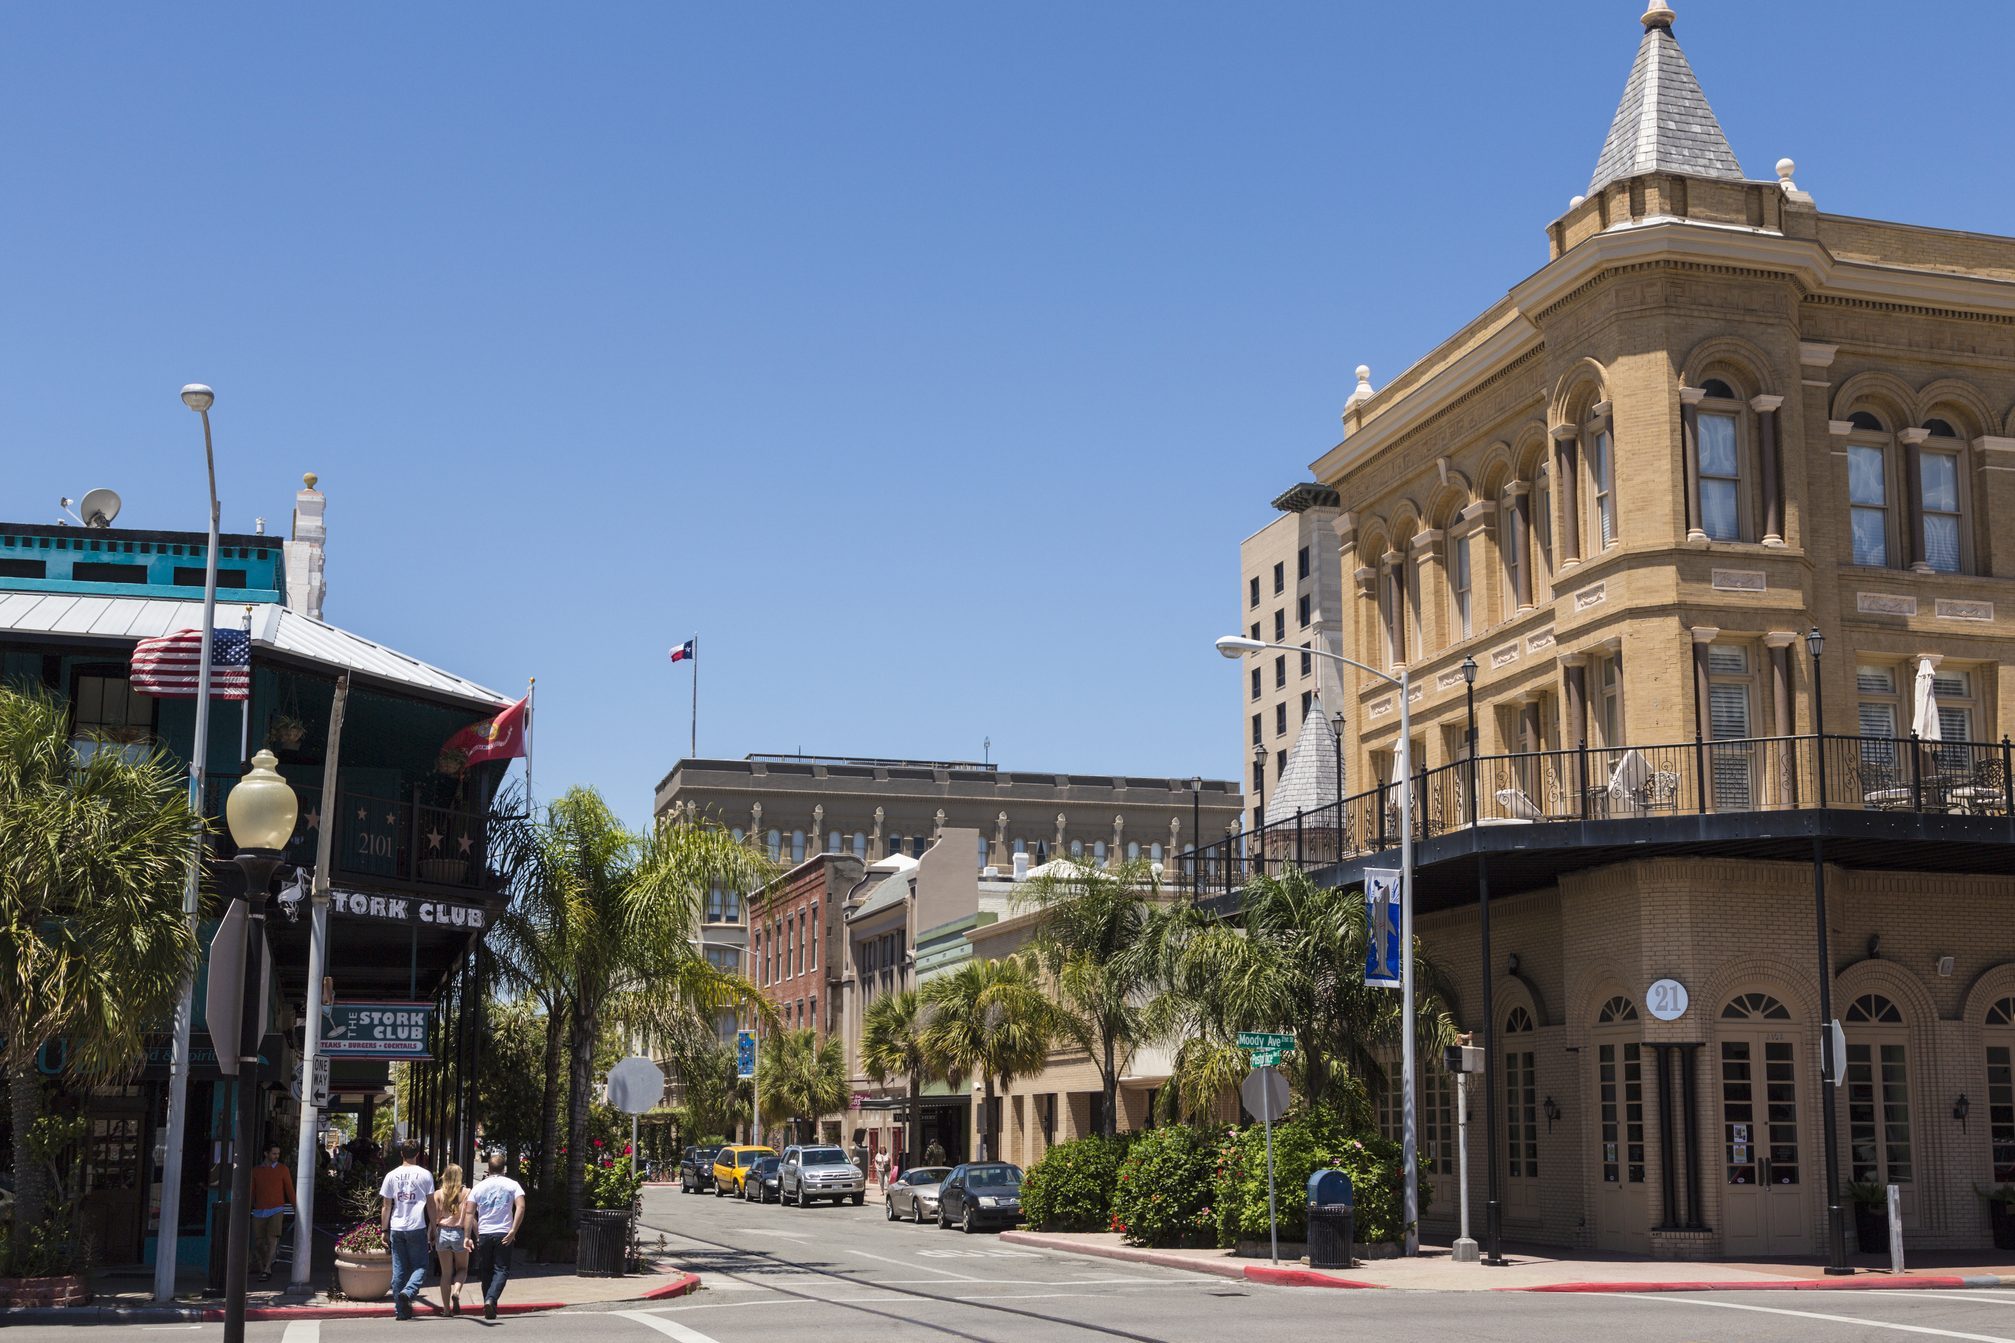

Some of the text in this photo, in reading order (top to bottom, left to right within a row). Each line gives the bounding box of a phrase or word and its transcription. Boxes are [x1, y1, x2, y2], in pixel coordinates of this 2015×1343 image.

[359, 832, 393, 859] 2101
[329, 891, 486, 928] TORK CLUB
[1655, 984, 1681, 1012] 21
[348, 1012, 358, 1039] THE
[360, 1011, 424, 1026] STORK
[373, 1026, 423, 1040] CLUB
[1239, 1034, 1264, 1048] Moody
[1267, 1036, 1281, 1047] Ave
[314, 1059, 328, 1072] ONE
[313, 1074, 328, 1087] WAY
